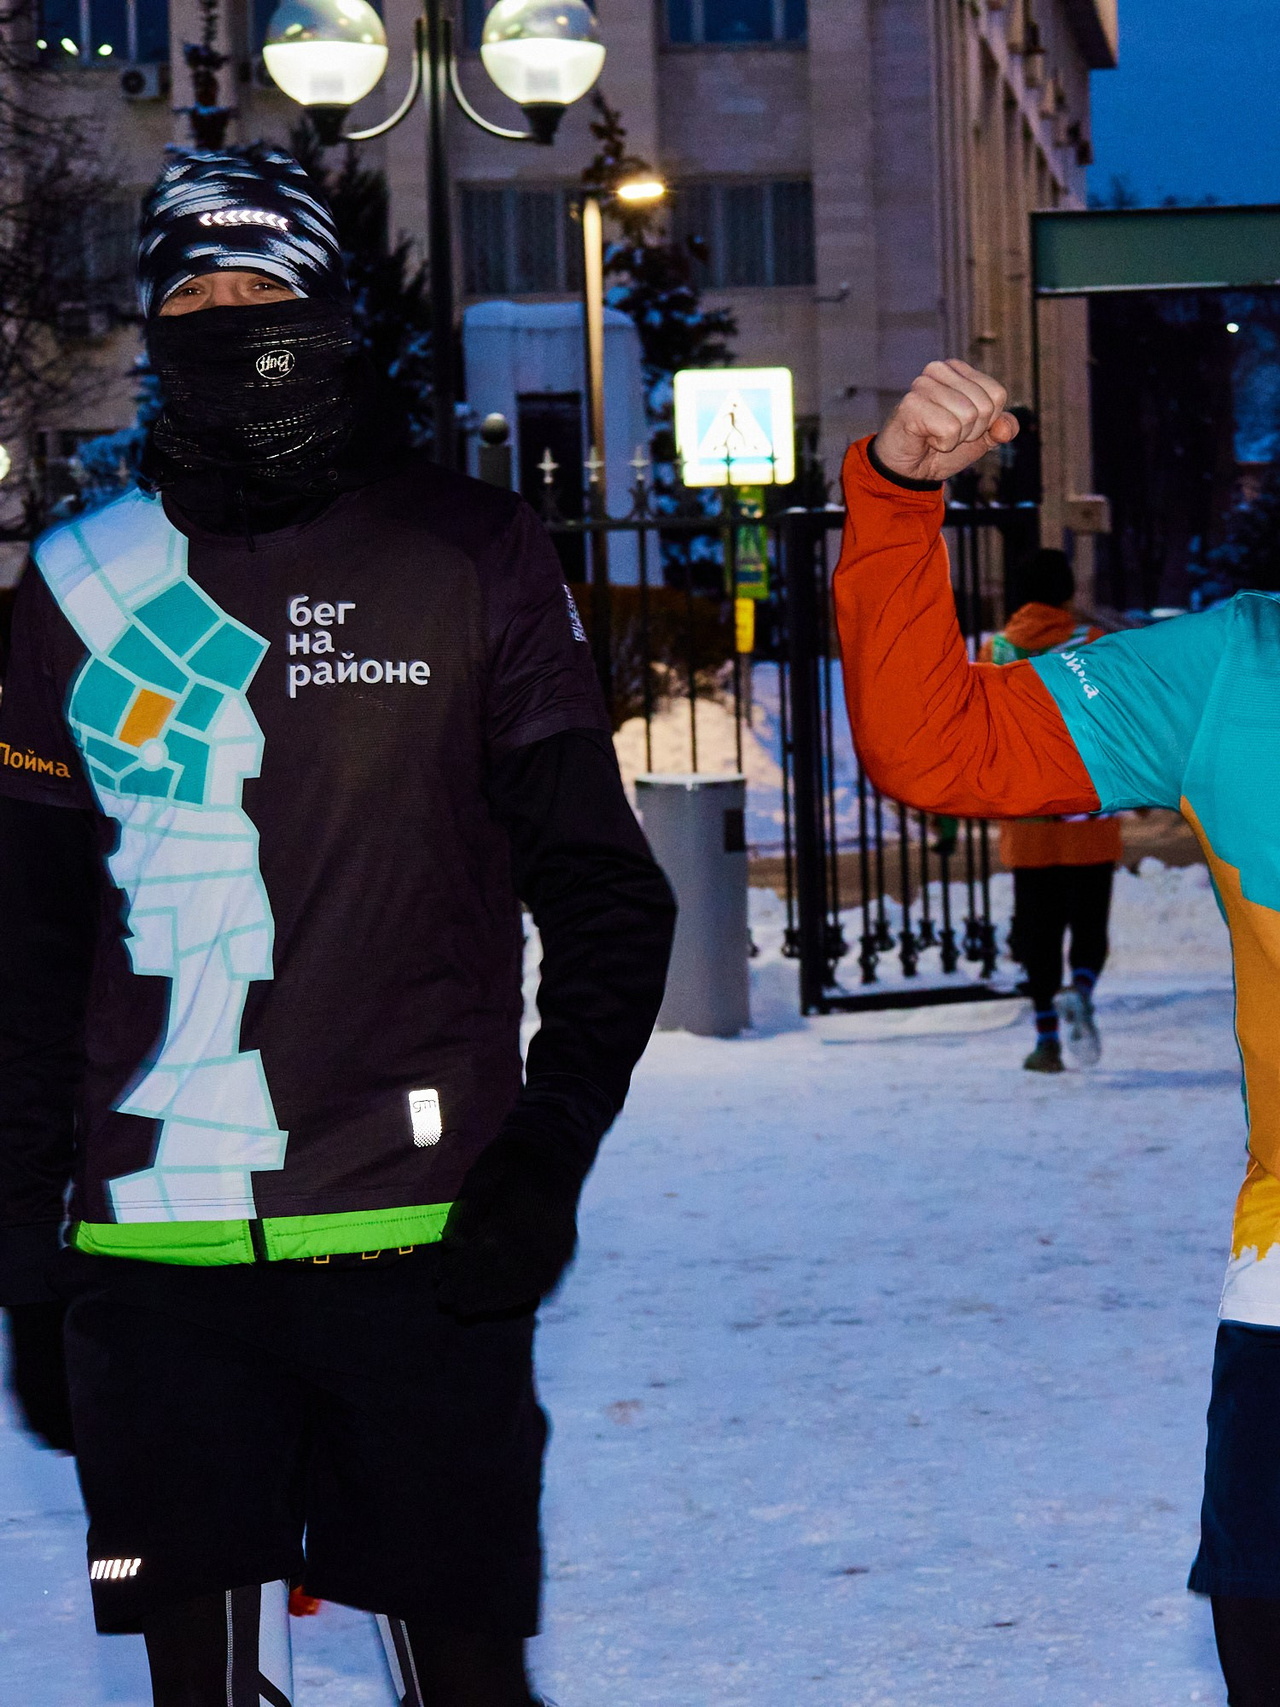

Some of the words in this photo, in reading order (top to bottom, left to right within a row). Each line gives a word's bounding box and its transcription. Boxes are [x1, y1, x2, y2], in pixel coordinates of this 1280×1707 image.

[288, 595, 356, 627] бег
[289, 629, 335, 656] на
[289, 652, 431, 699] районе
